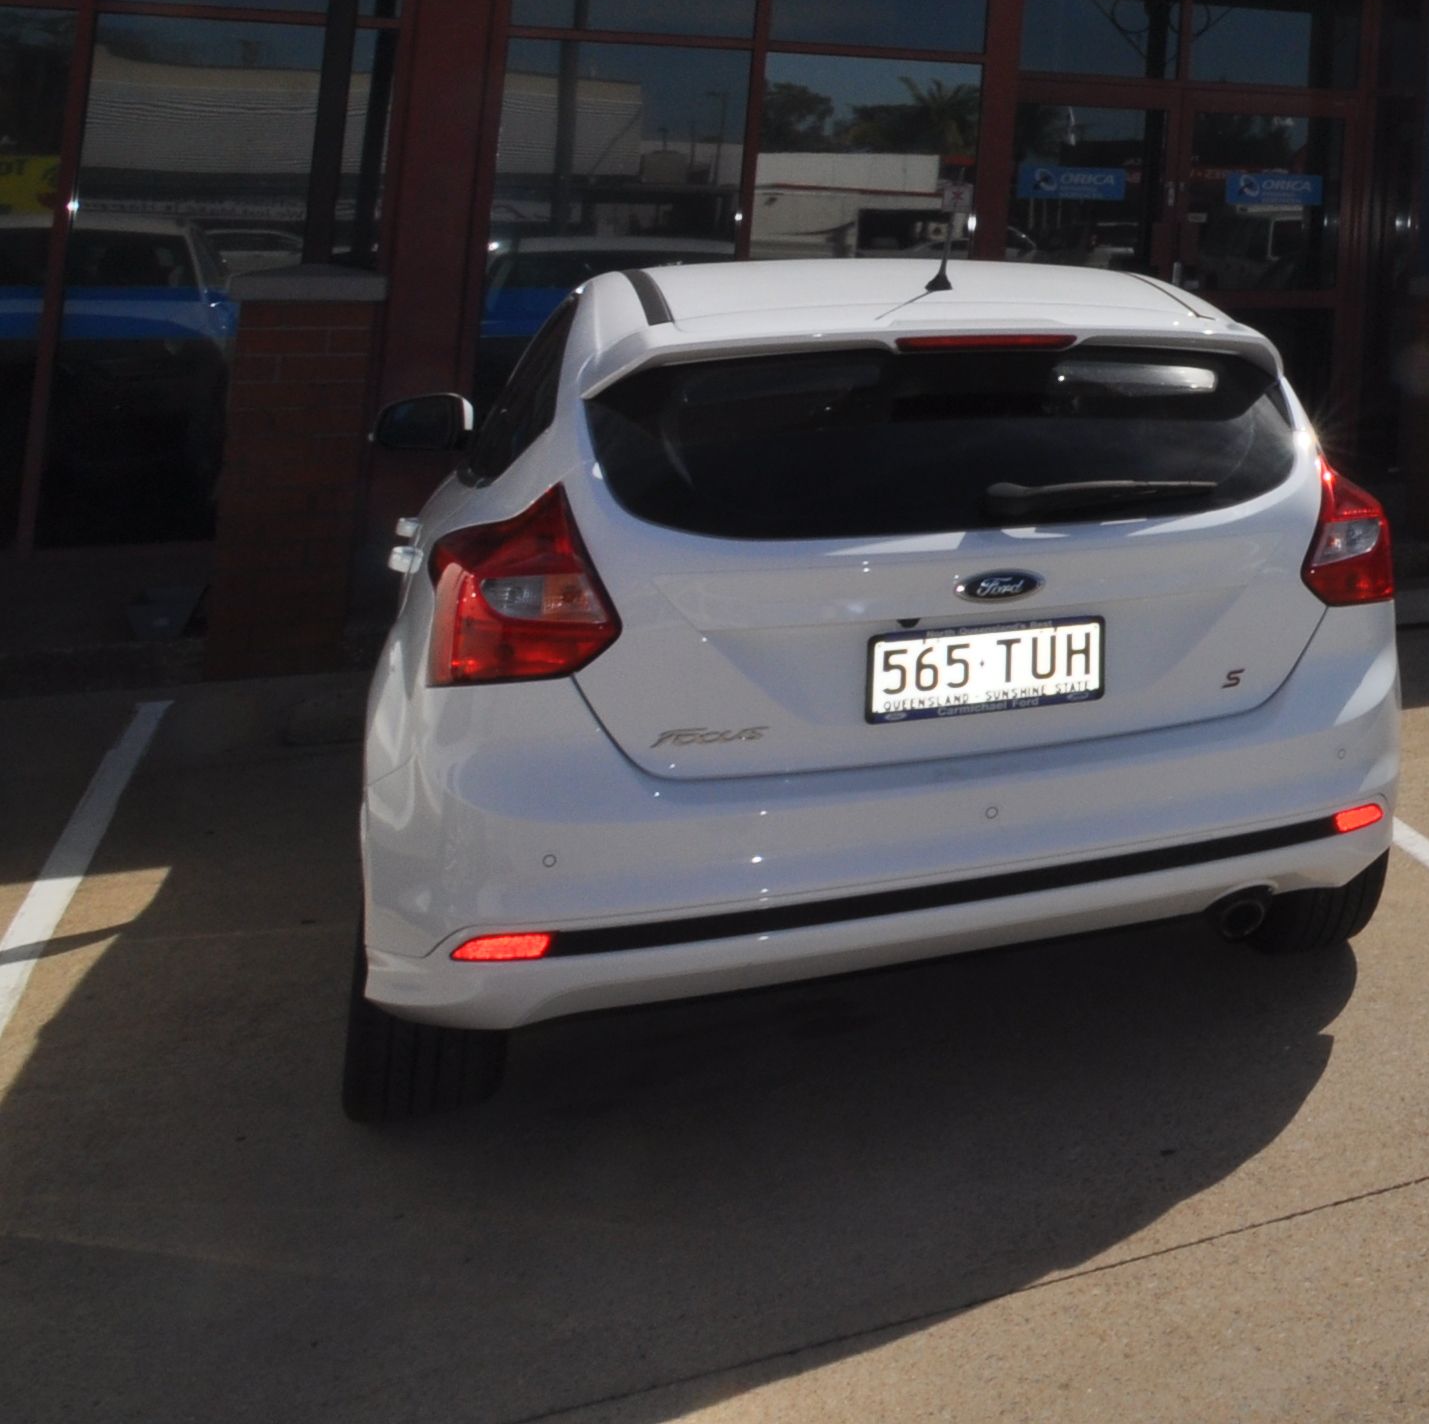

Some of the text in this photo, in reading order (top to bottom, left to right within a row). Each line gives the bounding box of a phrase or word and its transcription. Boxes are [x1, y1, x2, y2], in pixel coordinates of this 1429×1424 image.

[1059, 173, 1115, 186] ORICA
[1261, 179, 1312, 192] ORICA
[977, 576, 1025, 596] Ford
[926, 628, 956, 638] North
[882, 632, 1091, 695] 565 TUH
[1222, 668, 1245, 689] S
[883, 680, 1091, 712] QUEENSLAND SUNSHINE STATE
[937, 696, 1039, 716] Carmichael Ford
